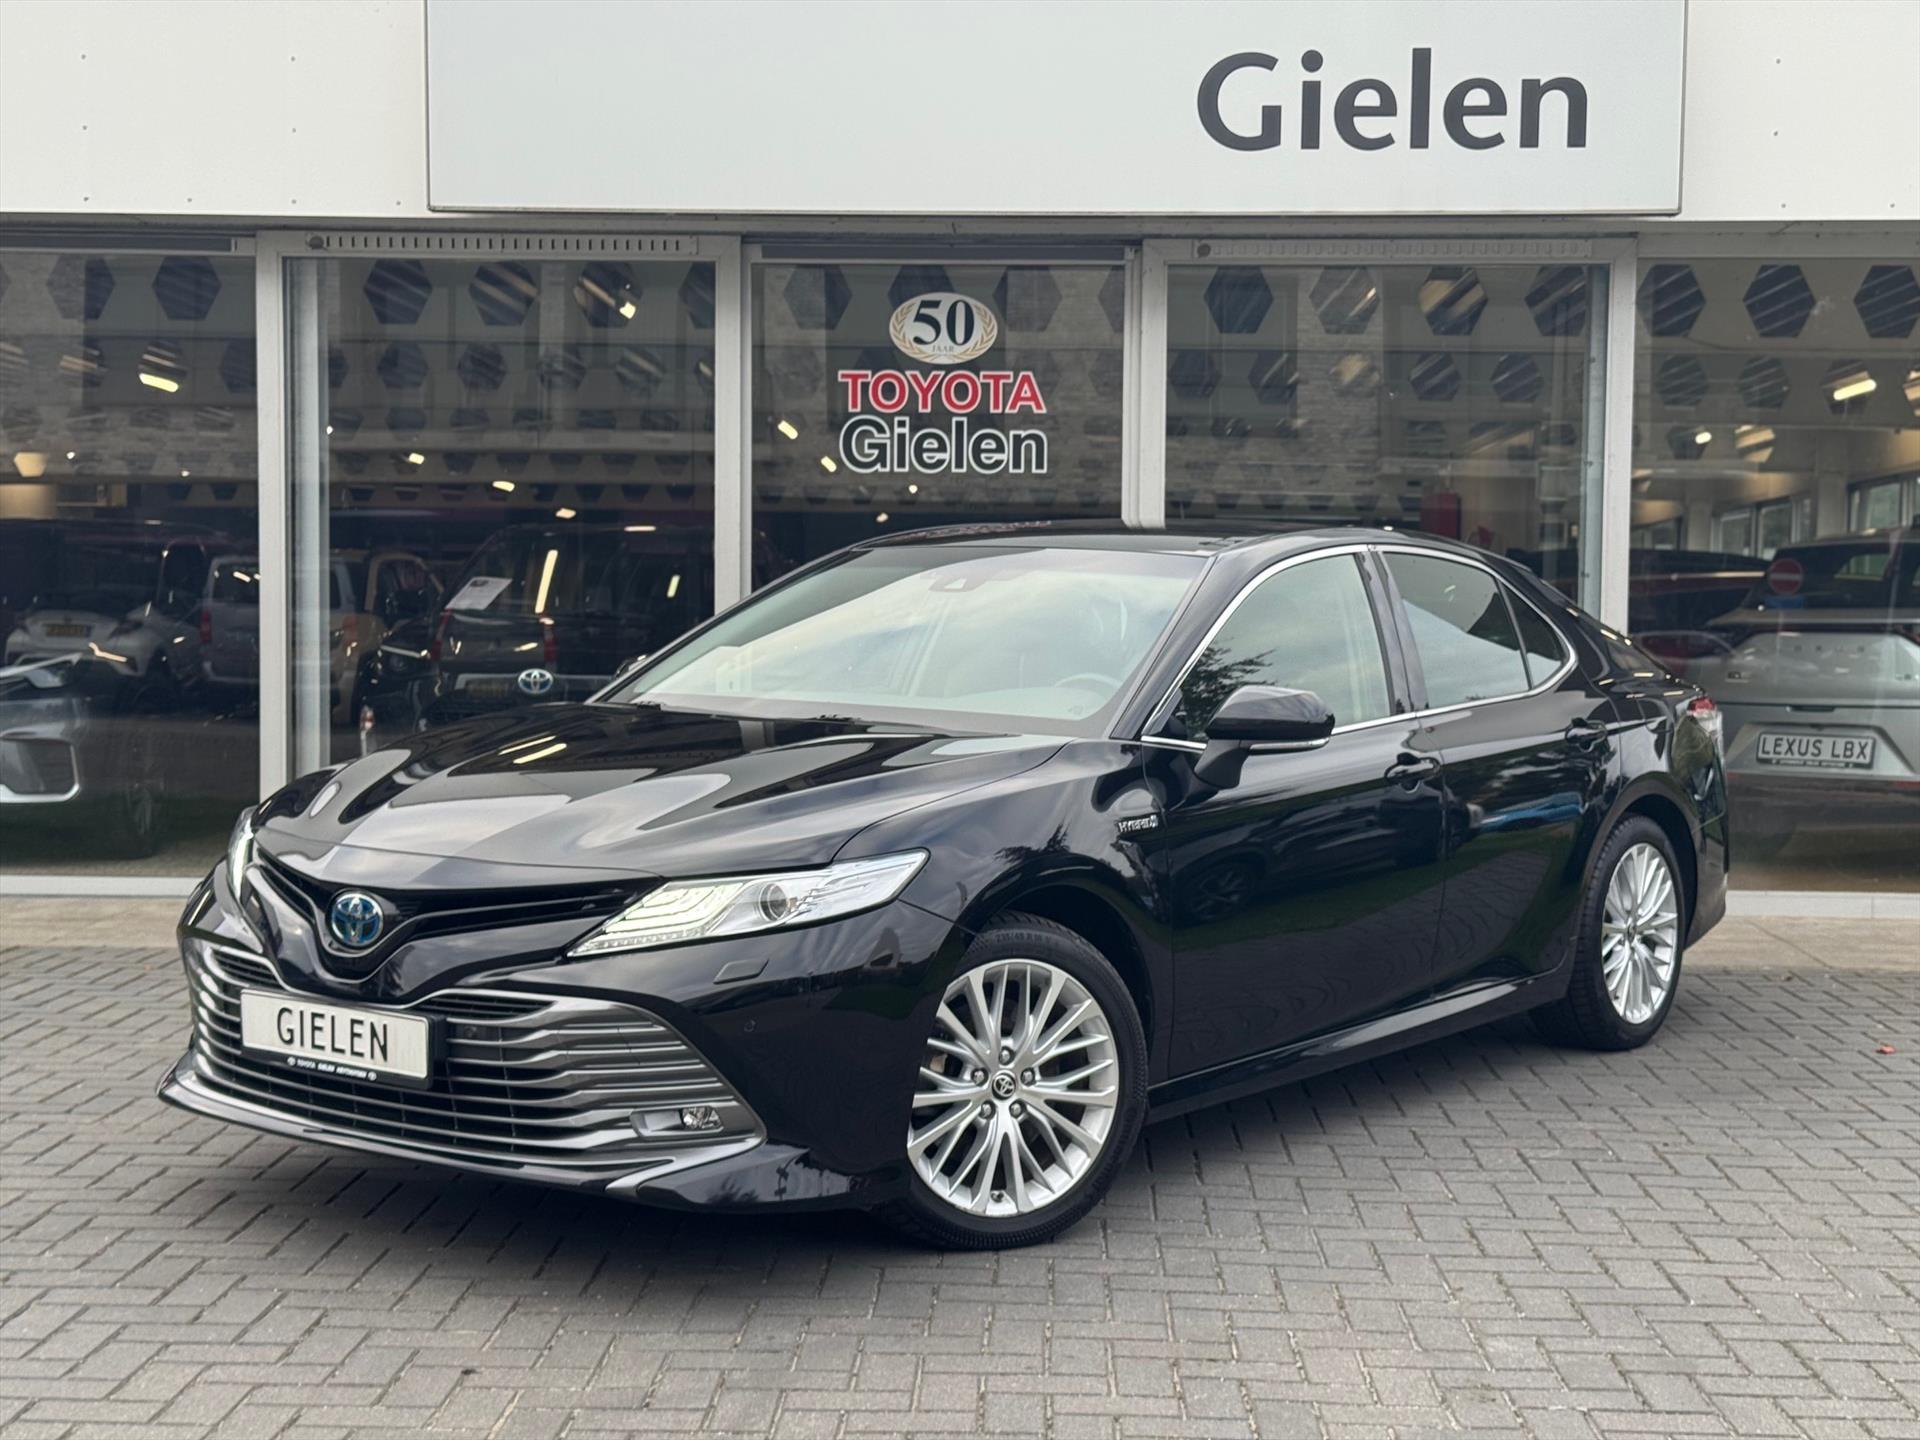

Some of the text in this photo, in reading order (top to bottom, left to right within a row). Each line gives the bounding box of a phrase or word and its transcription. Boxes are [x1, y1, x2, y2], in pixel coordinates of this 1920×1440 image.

[1197, 47, 1588, 152] Gielen
[912, 299, 975, 346] 50
[838, 370, 1047, 414] TOYOTA
[839, 414, 1048, 474] Gielen
[1761, 736, 1869, 760] LEXUS LBX
[276, 1006, 388, 1063] GIELEN
